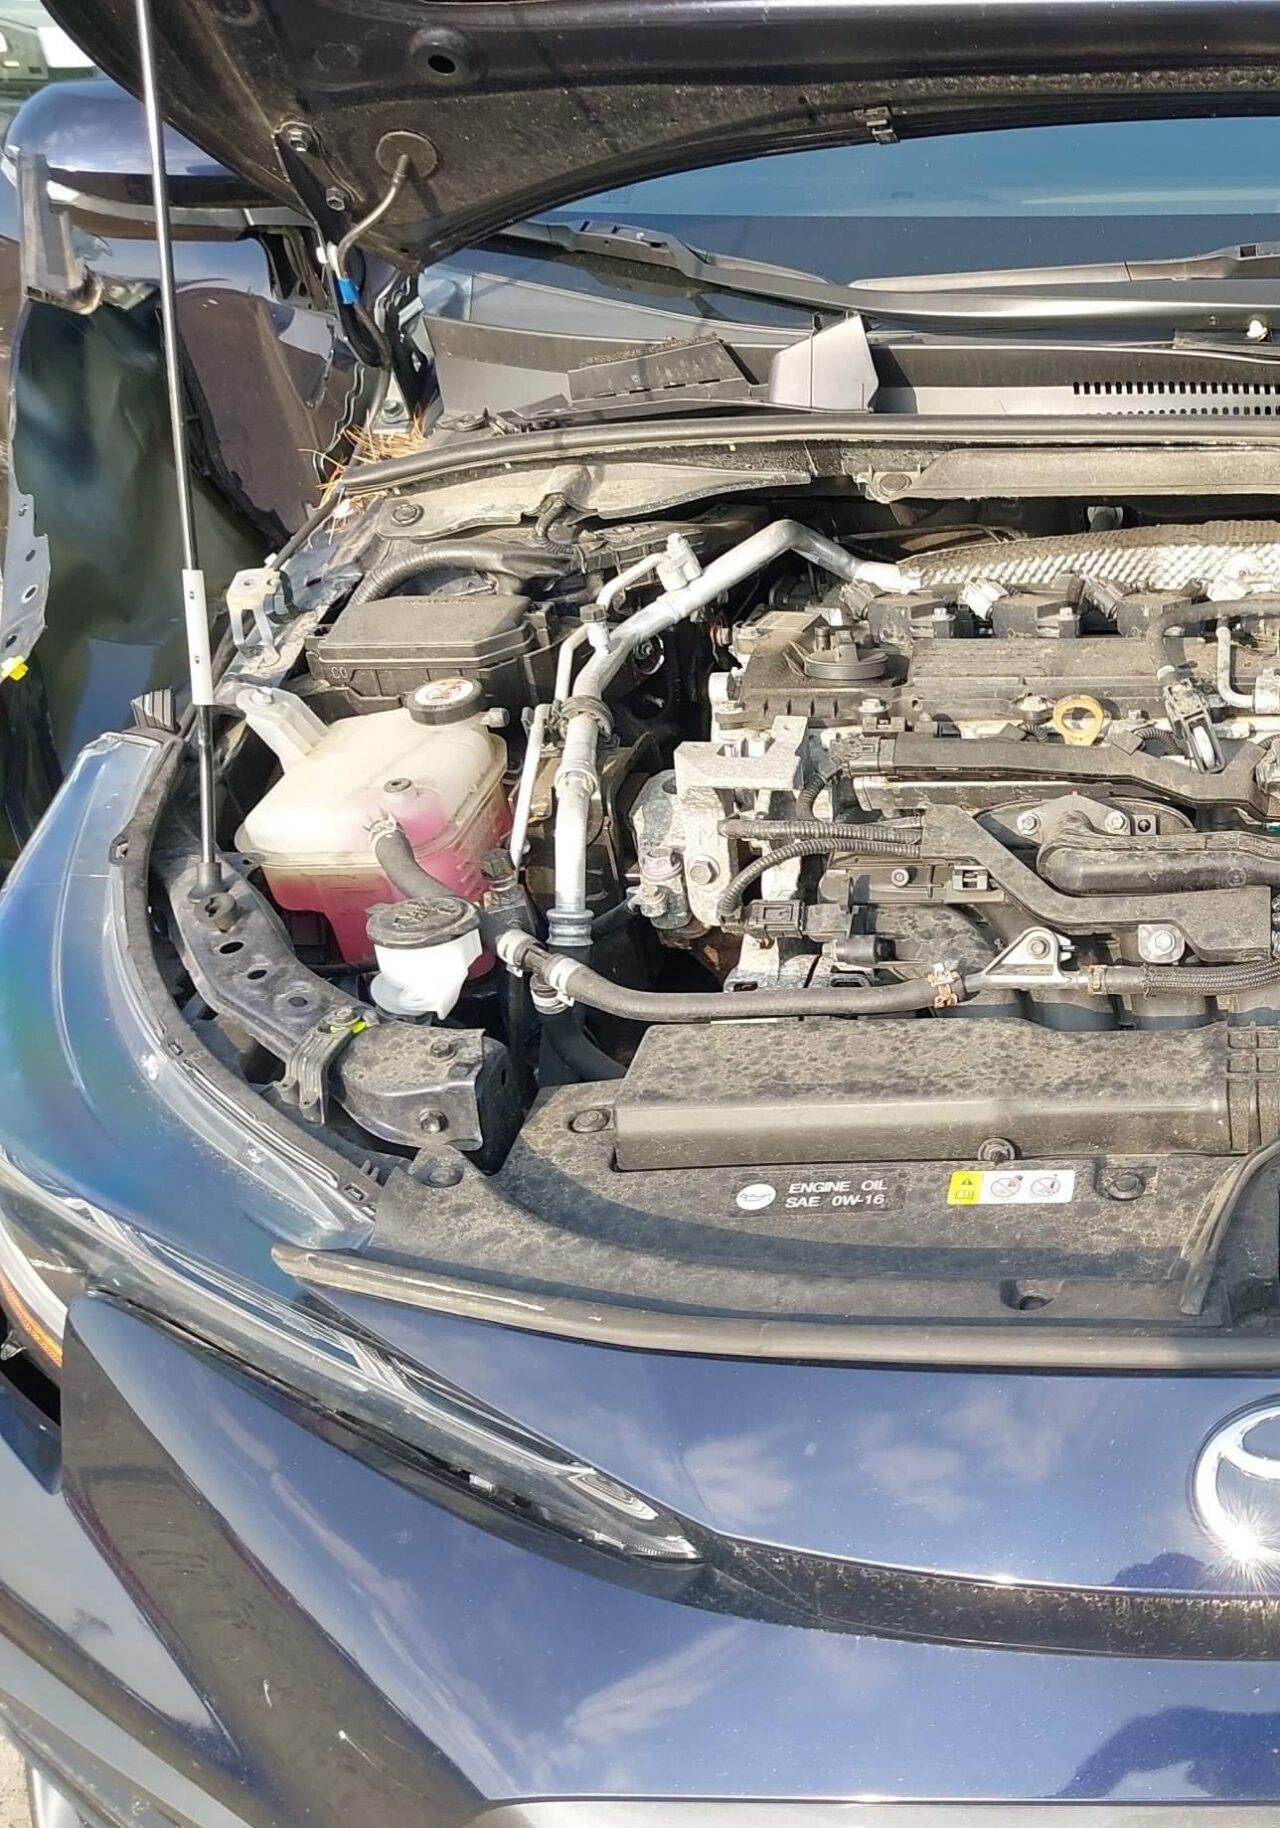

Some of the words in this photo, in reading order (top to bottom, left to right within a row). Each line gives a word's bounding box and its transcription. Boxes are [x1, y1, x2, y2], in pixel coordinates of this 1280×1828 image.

[788, 1181, 851, 1194] ENGINE
[860, 1180, 888, 1191] OIL
[785, 1196, 821, 1209] SAE
[831, 1193, 885, 1207] 0W-16
